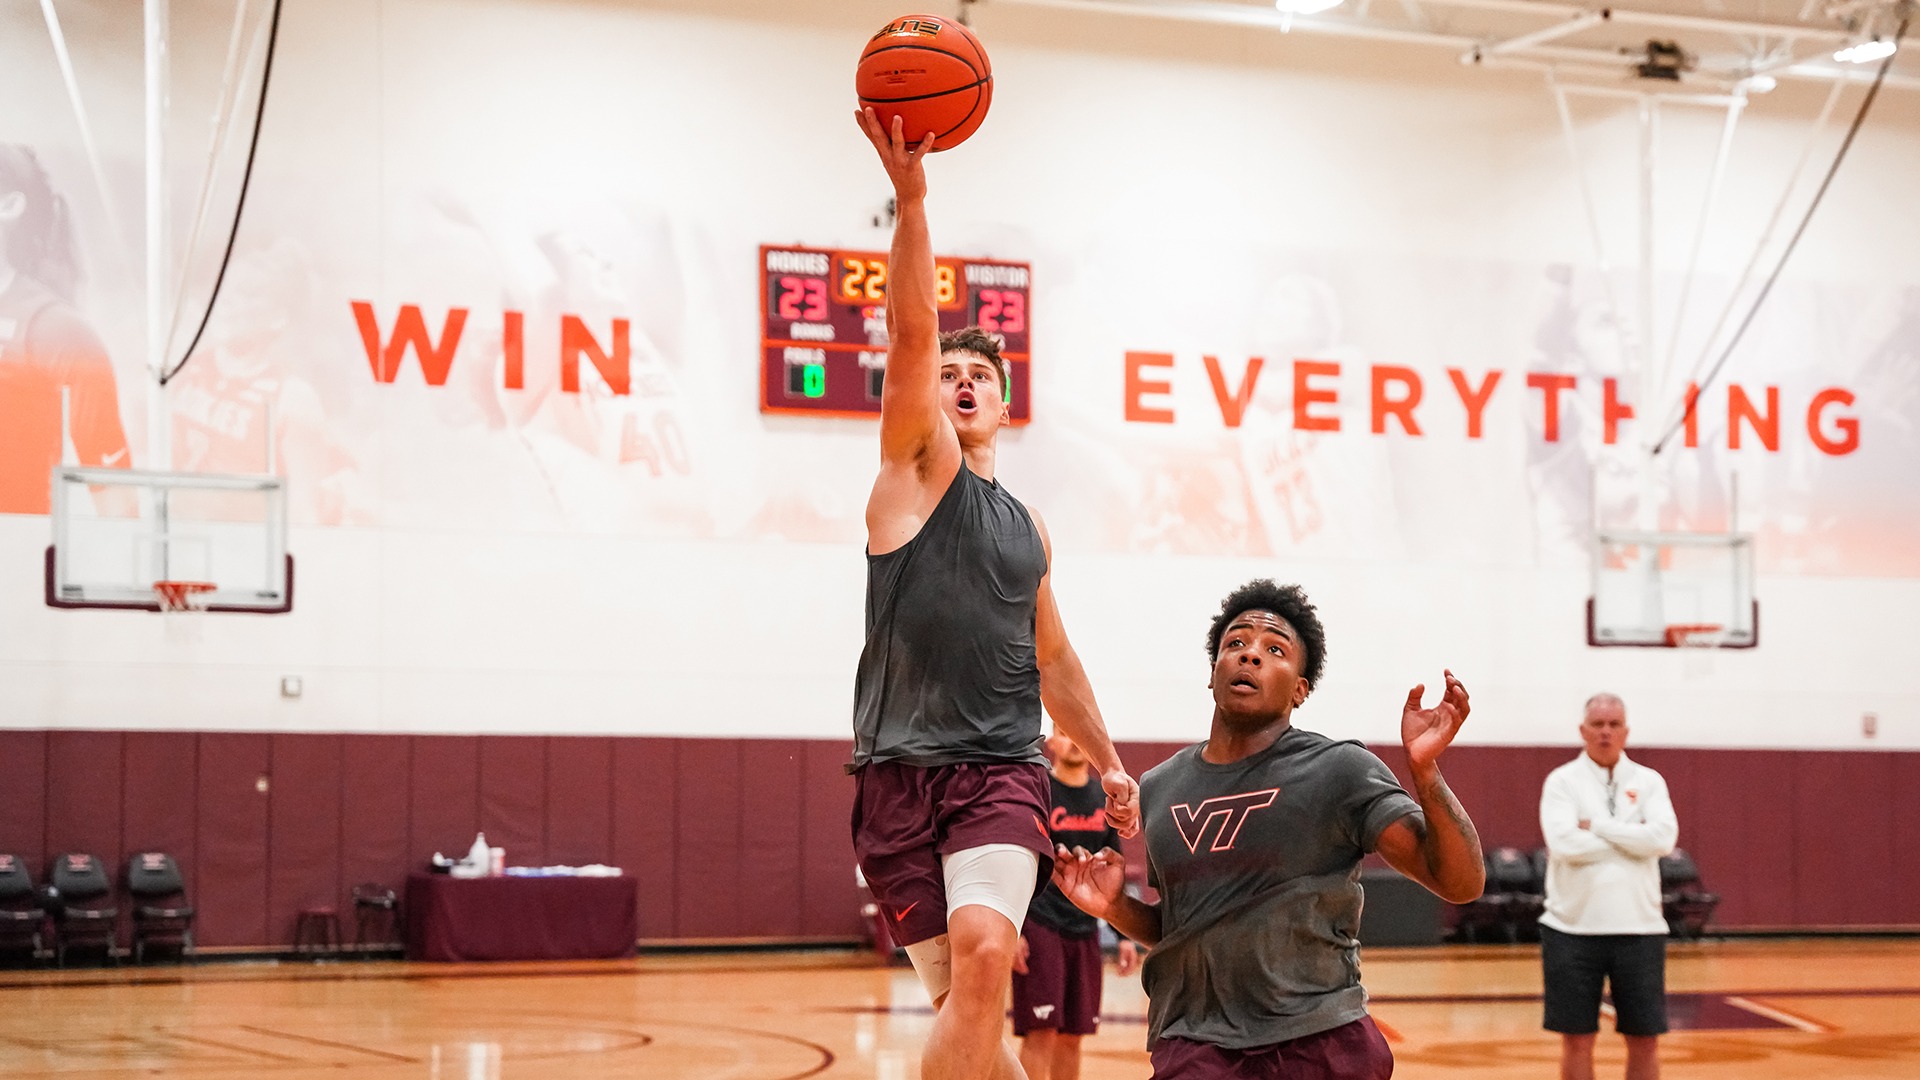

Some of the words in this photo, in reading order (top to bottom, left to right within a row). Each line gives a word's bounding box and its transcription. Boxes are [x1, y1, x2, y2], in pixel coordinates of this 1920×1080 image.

[767, 250, 829, 276] HOKIES
[965, 263, 1030, 289] VISITOR
[779, 277, 827, 321] 23
[978, 289, 1025, 333] 23
[350, 300, 632, 397] WIN
[803, 363, 825, 398] 0
[1170, 787, 1280, 855] VT
